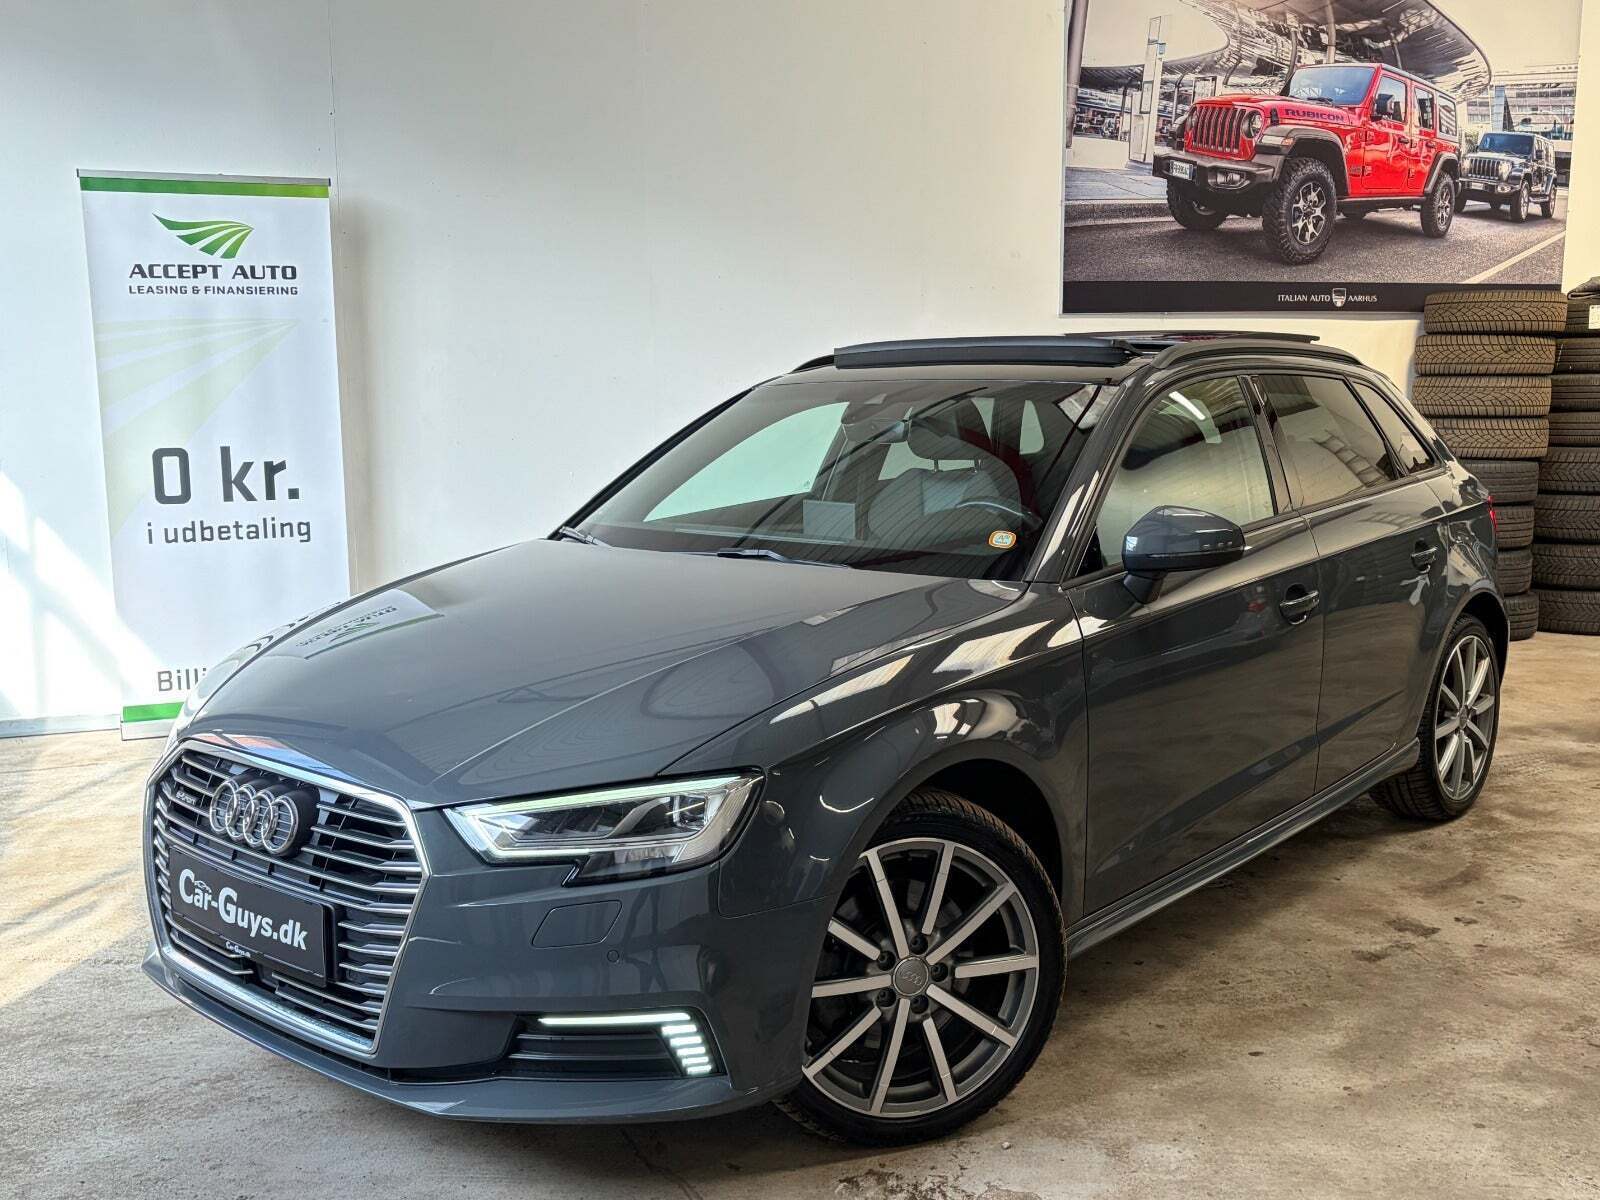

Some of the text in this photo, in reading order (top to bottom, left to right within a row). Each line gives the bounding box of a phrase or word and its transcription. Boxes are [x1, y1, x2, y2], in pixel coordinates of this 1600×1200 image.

[1284, 107, 1345, 122] RUBICON
[128, 263, 297, 280] ACCEPT AUTO
[128, 285, 298, 295] LEASING & FINANSIERING
[1277, 294, 1378, 302] ITALIAN AUTO AARHUS
[151, 445, 300, 505] 0 kr.
[147, 517, 311, 544] i udbetaling
[179, 869, 308, 951] Car-Guys.dk
